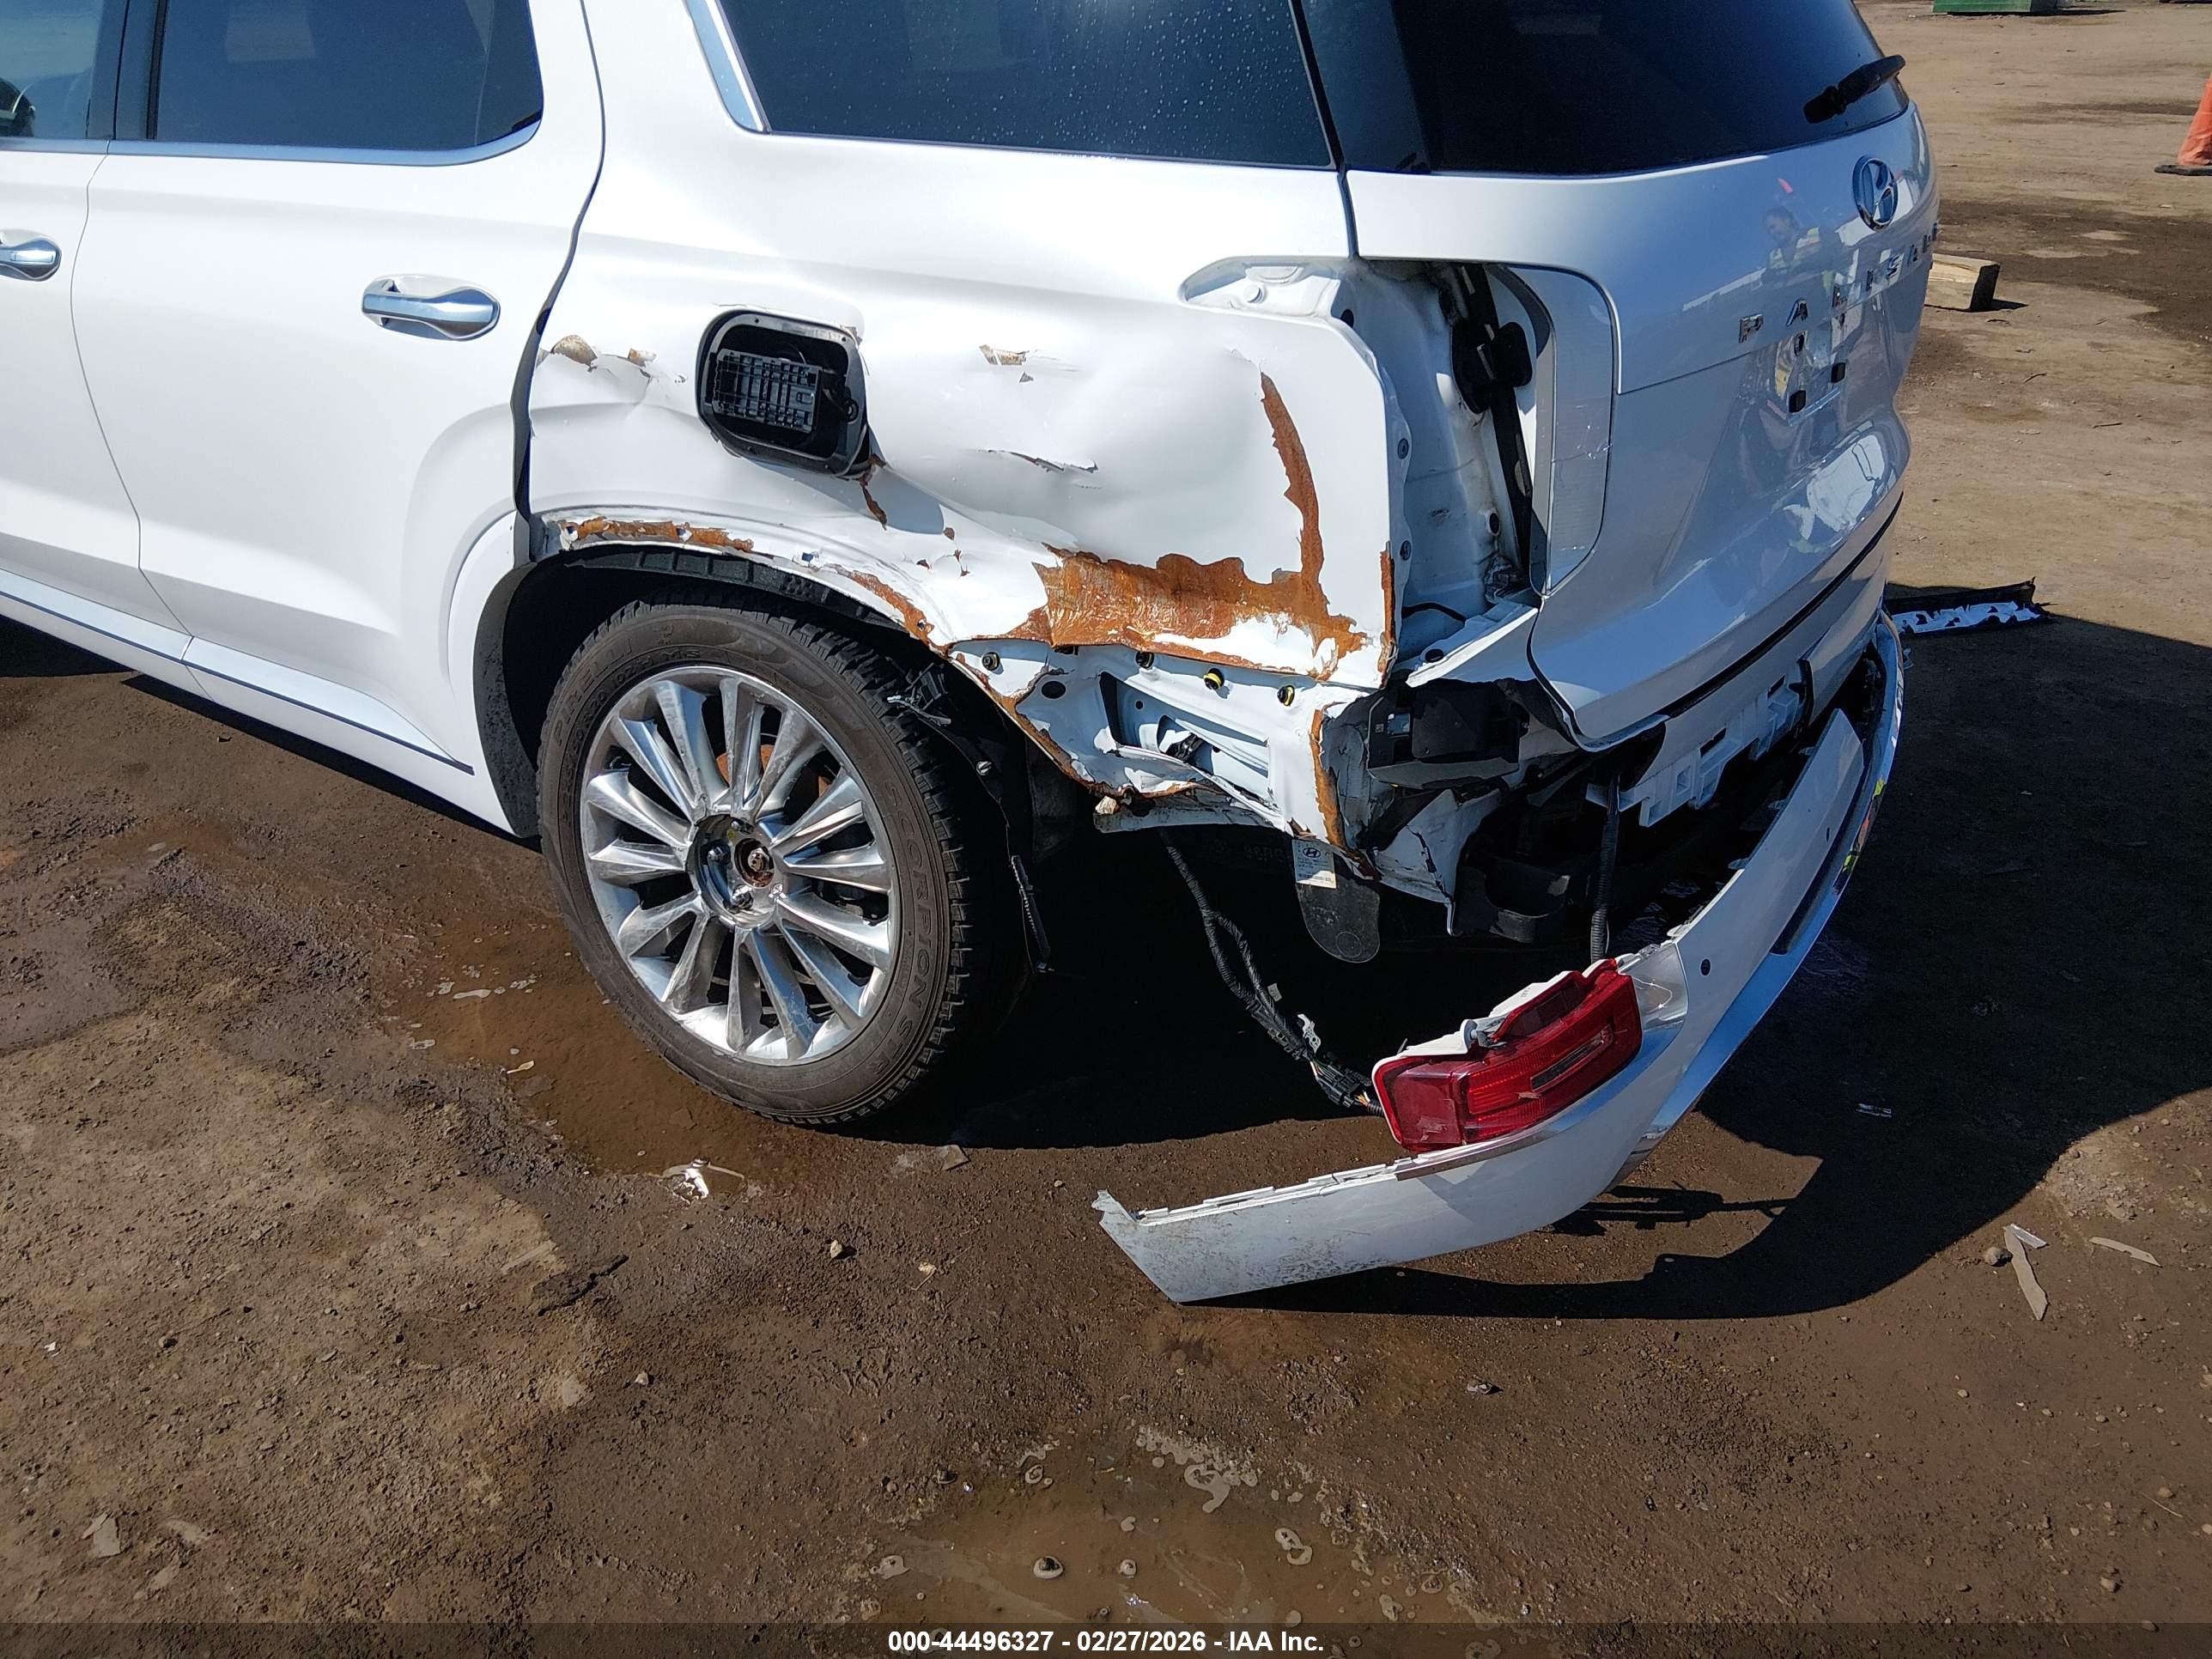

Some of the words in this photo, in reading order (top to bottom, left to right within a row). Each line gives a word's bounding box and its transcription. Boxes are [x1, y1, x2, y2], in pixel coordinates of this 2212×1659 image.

[554, 637, 634, 746] PIRELLI
[883, 780, 931, 1010] SCORPION
[867, 1015, 914, 1075] STR
